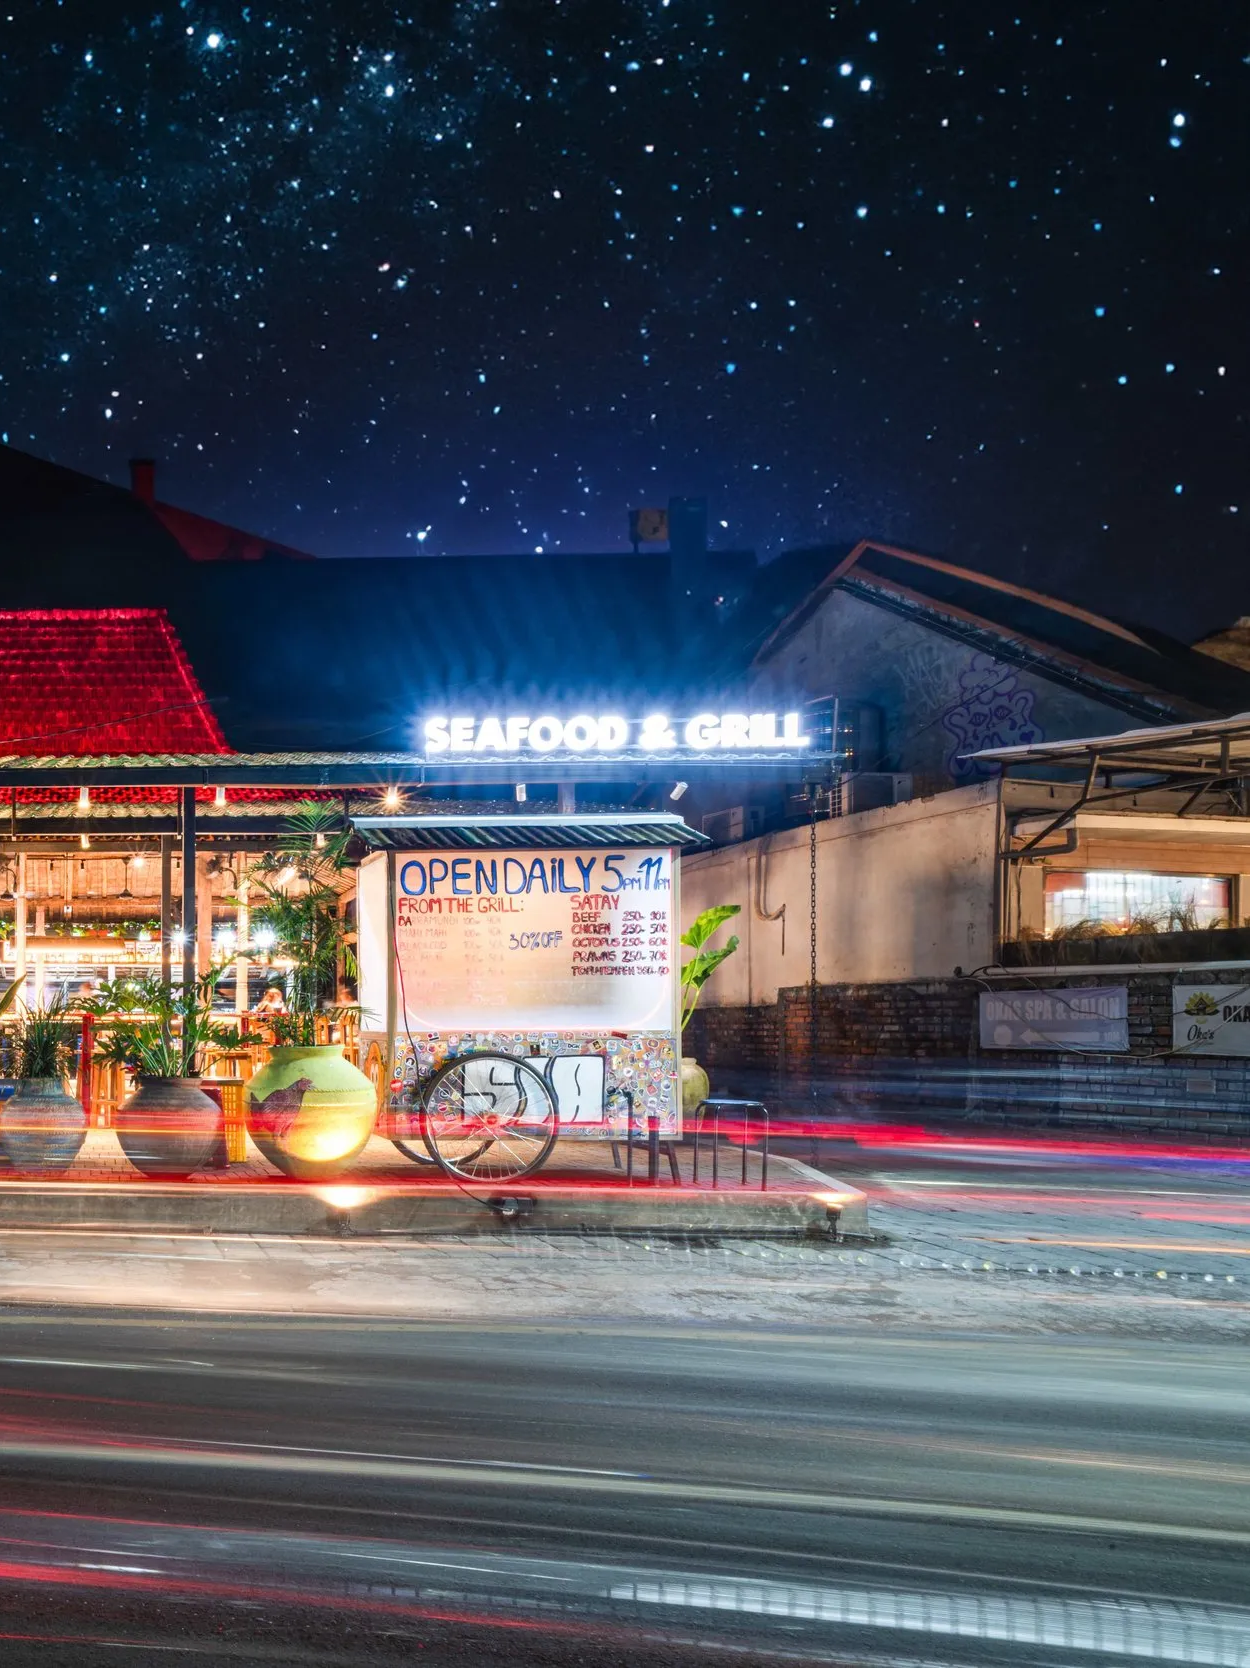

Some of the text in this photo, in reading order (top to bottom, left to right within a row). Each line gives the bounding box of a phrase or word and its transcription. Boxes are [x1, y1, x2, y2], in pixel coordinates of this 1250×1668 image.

[424, 713, 810, 753] SEAFOOD & GRILL
[400, 858, 497, 896] OPEN
[398, 897, 442, 914] FROM
[444, 897, 474, 914] THE
[570, 894, 620, 910] SATAY
[572, 911, 601, 923] BEEF
[571, 923, 611, 935] CHICKEN
[572, 937, 620, 948] OCTOPUS
[572, 951, 617, 962] PRAWNS
[1024, 999, 1052, 1021] SPA
[1055, 1002, 1067, 1020] &
[1070, 998, 1120, 1021] SALON
